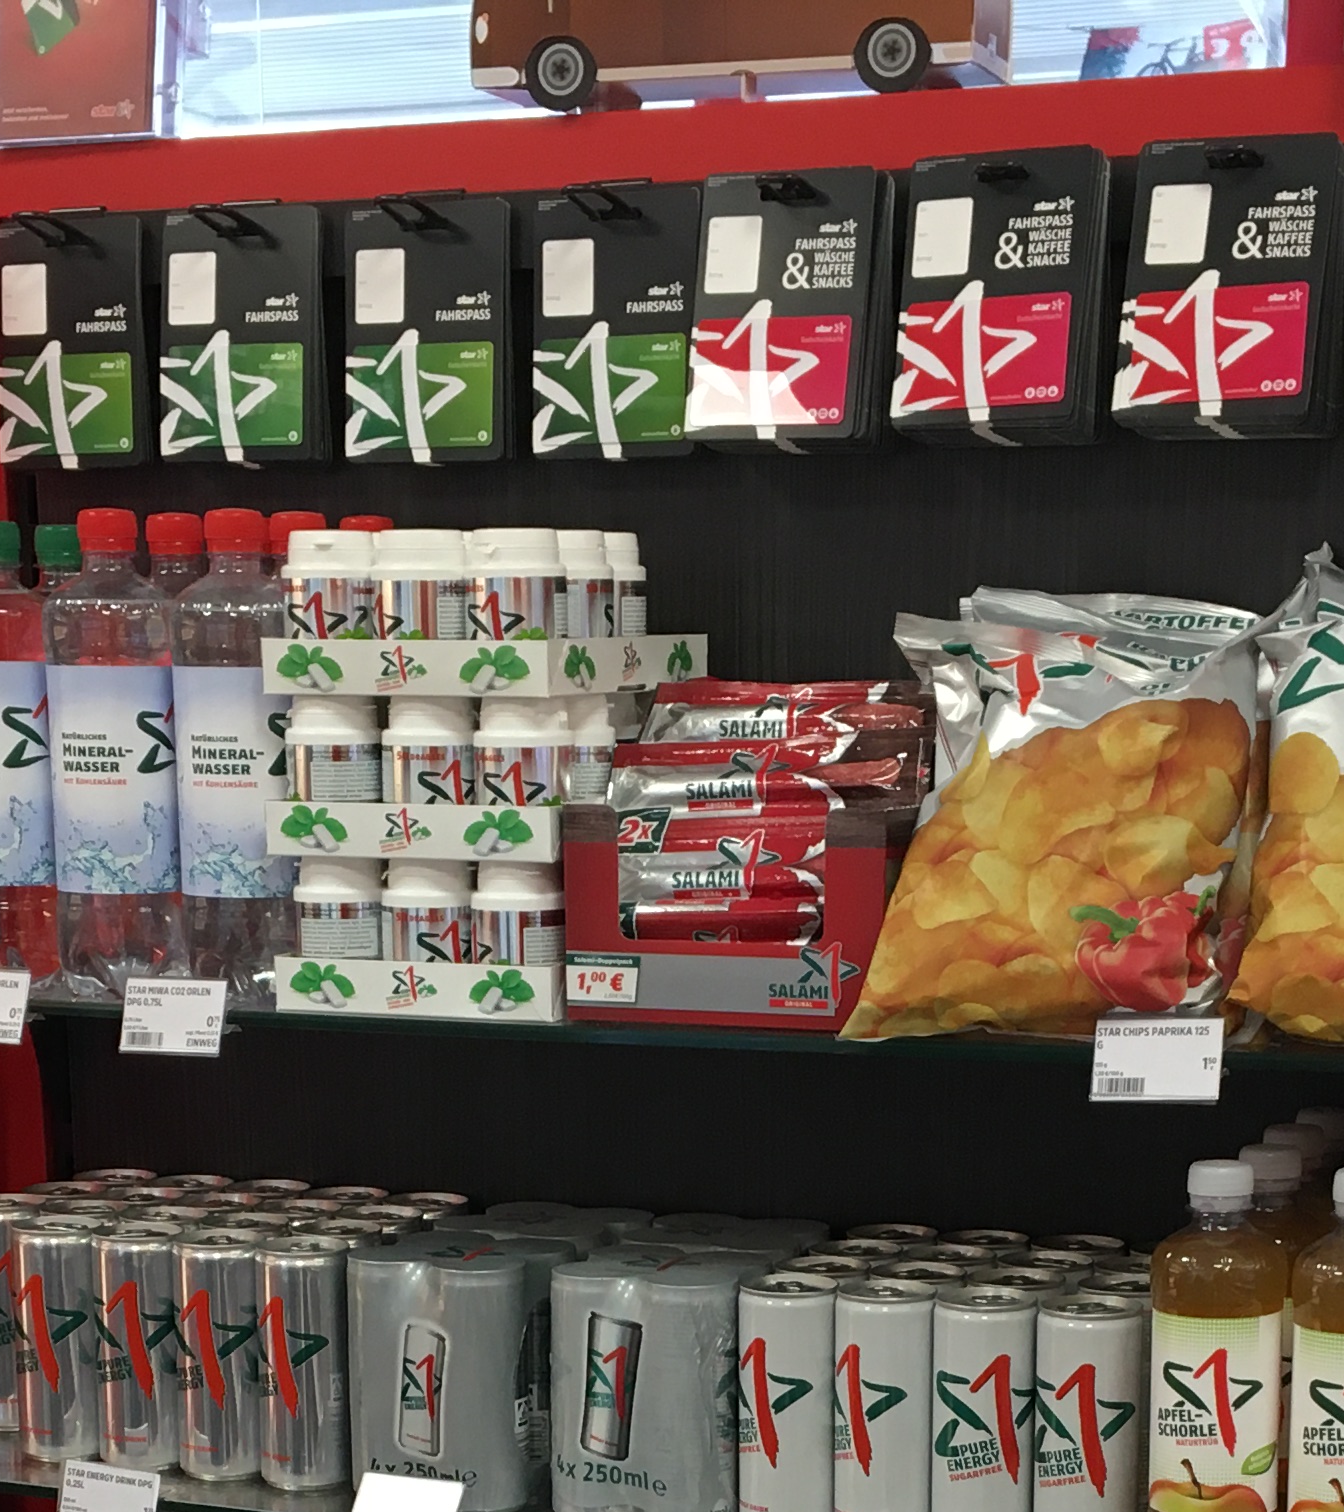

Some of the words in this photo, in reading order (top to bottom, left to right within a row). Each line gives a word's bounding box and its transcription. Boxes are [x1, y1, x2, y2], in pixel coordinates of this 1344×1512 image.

[1248, 205, 1316, 219] FAHRSPASS
[1008, 214, 1073, 229] FAHRSPASS
[1268, 219, 1314, 232] WÄSCHE
[1028, 228, 1072, 241] WÄSCHE
[1232, 221, 1263, 260] &
[1267, 232, 1313, 245] KAFFEE
[796, 238, 856, 250] FAHRSPASS
[994, 232, 1024, 269] &
[1028, 241, 1070, 254] KAFFEE
[814, 251, 855, 262] WÄSCHE
[1265, 245, 1311, 258] SNACKS
[1026, 253, 1070, 267] SNACKS
[782, 252, 810, 290] &
[814, 264, 854, 276] KAFFEE
[812, 276, 853, 288] SNACKS
[626, 300, 683, 313] FAHRSPASS
[245, 310, 298, 322] FAHRSPASS
[436, 309, 490, 322] FAHRSPASS
[76, 321, 126, 333] FAHRSPASS
[719, 718, 783, 739] SALAMI
[63, 744, 133, 759] MINERAL-
[192, 746, 264, 761] MINERAL-
[64, 761, 120, 773] WASSER
[192, 763, 251, 776] WASSER
[685, 780, 752, 801] SALAMI
[619, 819, 654, 844] 2x
[672, 870, 739, 889] SALAMI
[128, 986, 146, 995] STAR
[148, 986, 168, 996] MIWA
[187, 986, 211, 996] ORLEN
[769, 983, 829, 999] SALAMI
[1098, 1027, 1121, 1036] STAR
[1123, 1027, 1149, 1036] CHIPS
[1152, 1026, 1192, 1036] PAPRIKA
[1195, 1026, 1210, 1035] 125
[186, 1038, 217, 1047] EINWEG
[1097, 1041, 1103, 1049] G
[1158, 1405, 1202, 1424] APFEL-
[1158, 1422, 1217, 1439] SCHORLE
[959, 1439, 998, 1458] PURE
[947, 1452, 1003, 1473] ENERGY
[1037, 1461, 1084, 1480] ENERGY
[68, 1468, 85, 1476] STAR
[87, 1471, 114, 1482] ENERGY
[115, 1476, 136, 1486] DRINK
[138, 1479, 152, 1488] DPG
